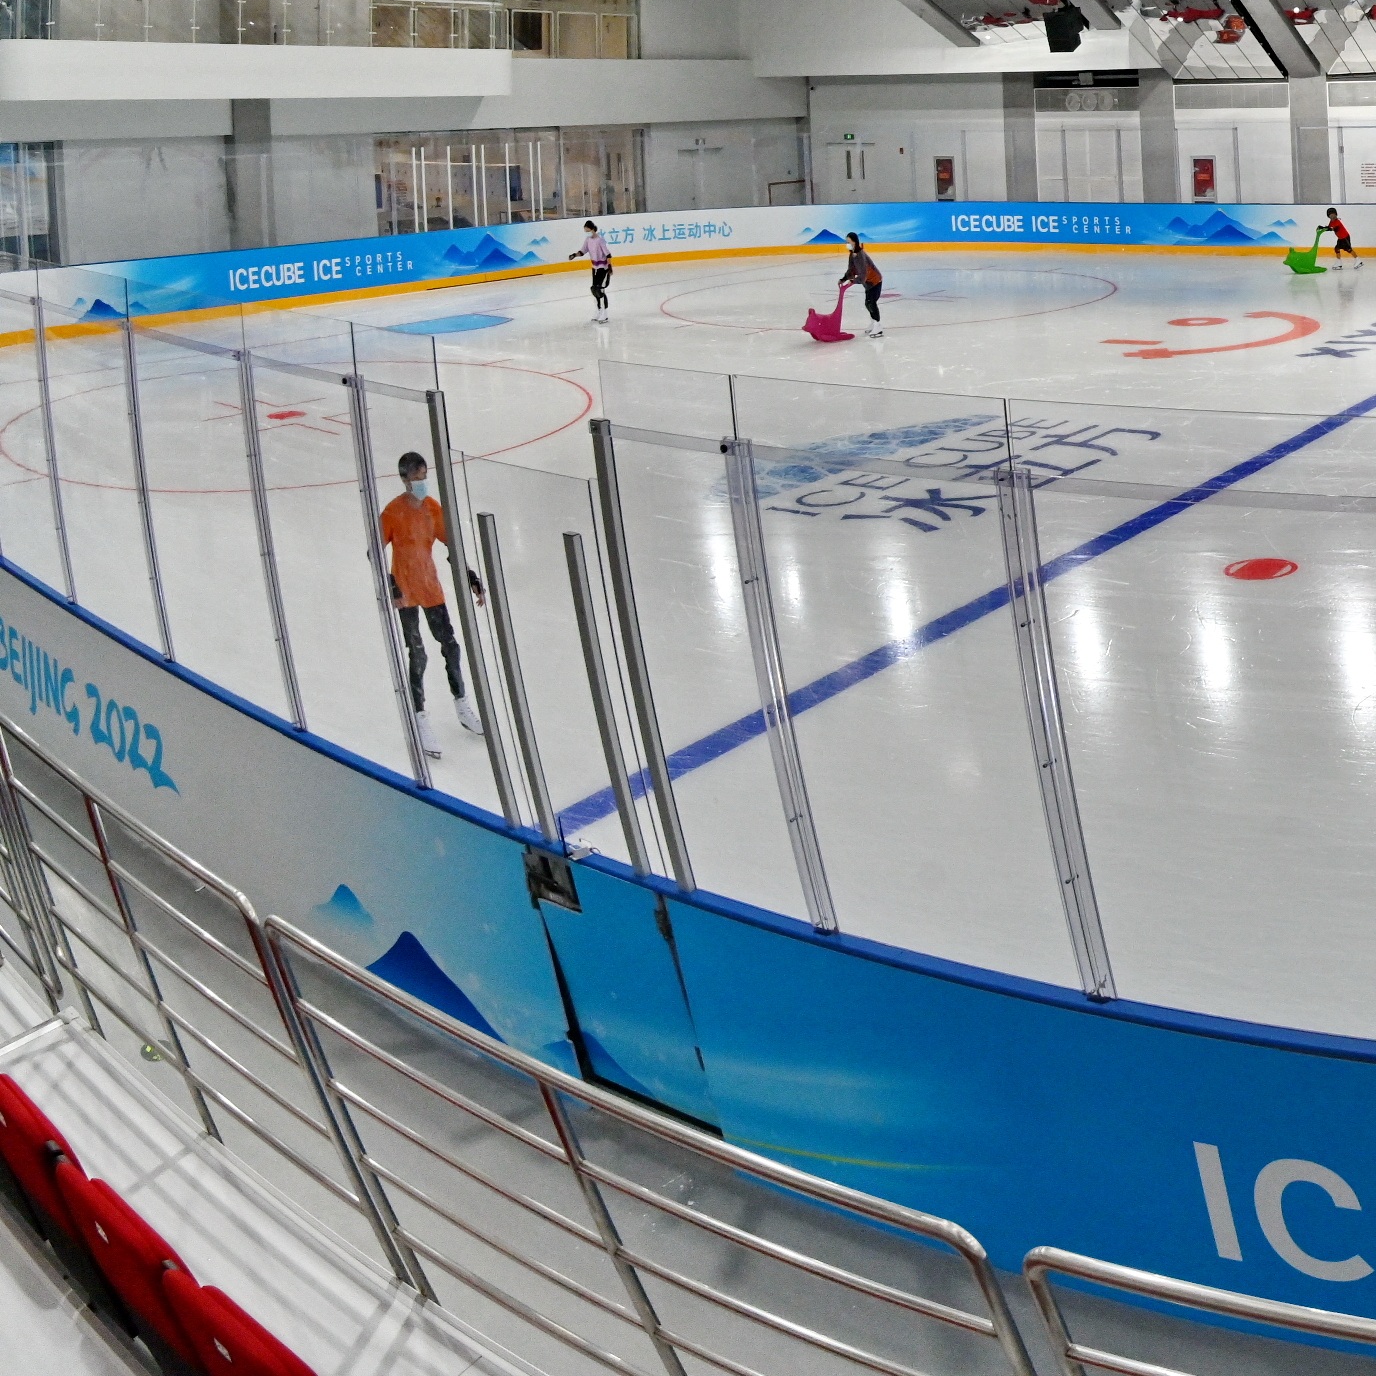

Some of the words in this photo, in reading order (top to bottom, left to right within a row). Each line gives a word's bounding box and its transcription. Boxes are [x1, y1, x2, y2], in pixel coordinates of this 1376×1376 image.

[642, 221, 733, 241] 冰上运动中心
[1032, 215, 1059, 233] ICE
[1062, 215, 1121, 225] SPORTS
[1072, 225, 1132, 235] CENTER
[313, 258, 342, 281] ICE
[345, 251, 402, 267] SPORTS
[355, 261, 414, 276] CENTER
[766, 473, 910, 517] ICE
[903, 417, 1069, 469] CUBE
[840, 424, 1162, 533] 冰立方
[85, 682, 181, 797] 2022
